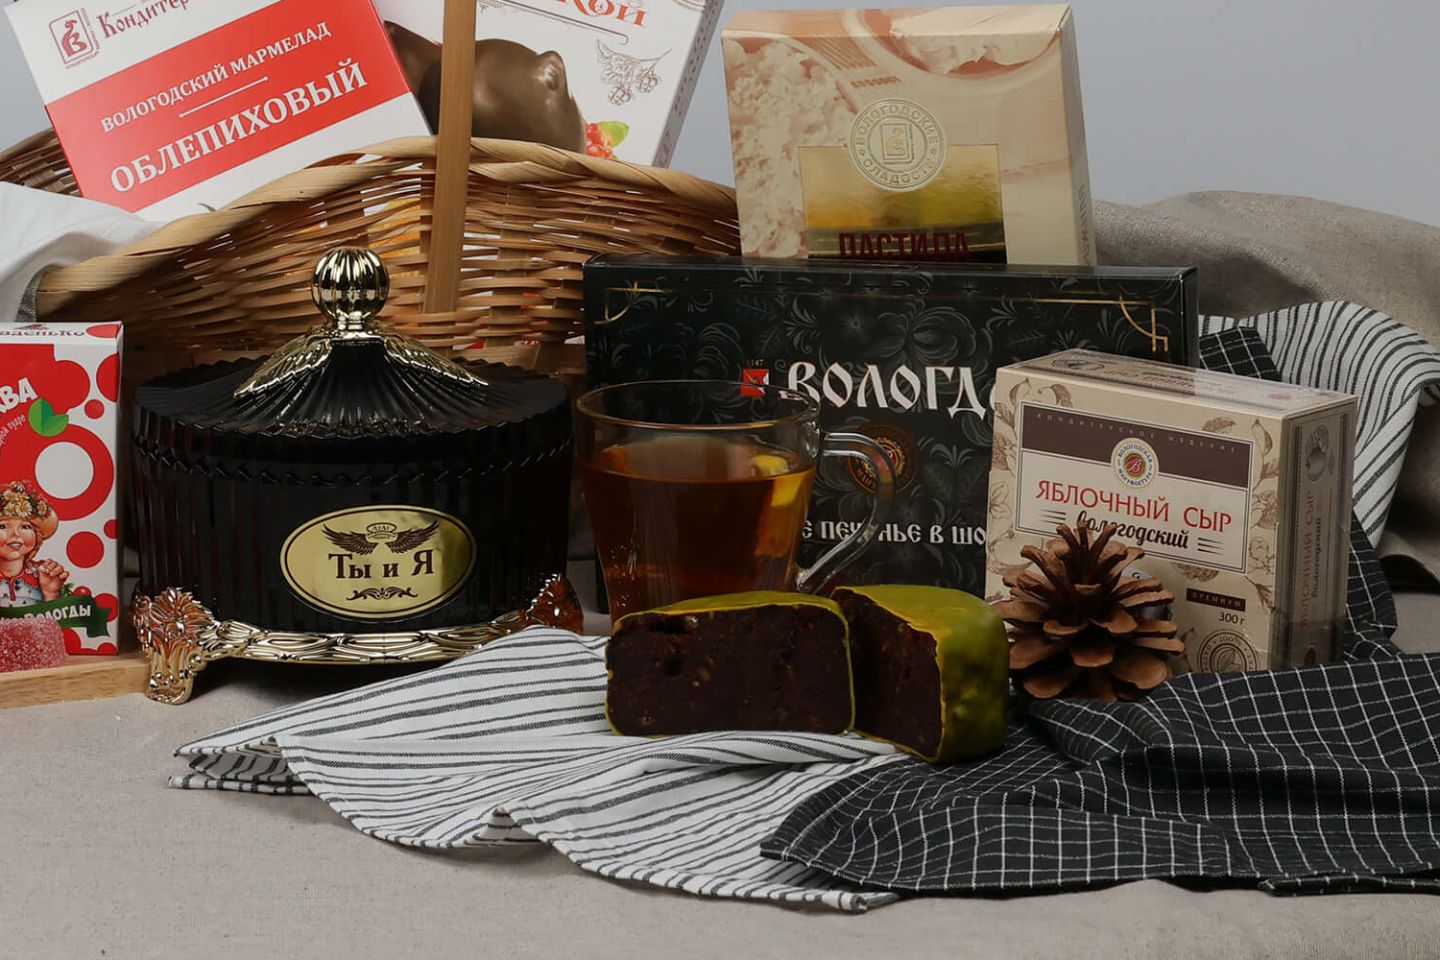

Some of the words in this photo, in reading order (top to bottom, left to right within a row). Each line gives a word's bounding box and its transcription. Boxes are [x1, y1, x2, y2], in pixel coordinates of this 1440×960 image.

[101, 62, 229, 133] ВОЛОГОДСКИЙ
[230, 20, 332, 75] МАРМЕЛАД
[110, 57, 369, 194] ОБЛЕПИХОВЫЙ
[838, 231, 971, 259] ПАСТИЛА
[788, 362, 996, 420] ВОЛОГД
[1035, 479, 1170, 523] ЯБЛОЧНЫЙ
[1182, 506, 1232, 533] СЫР
[820, 520, 922, 544] ПЕЧНЬЕ
[328, 553, 371, 579] Ты
[383, 562, 398, 577] и
[412, 549, 434, 576] Я
[1219, 611, 1239, 624] 300
